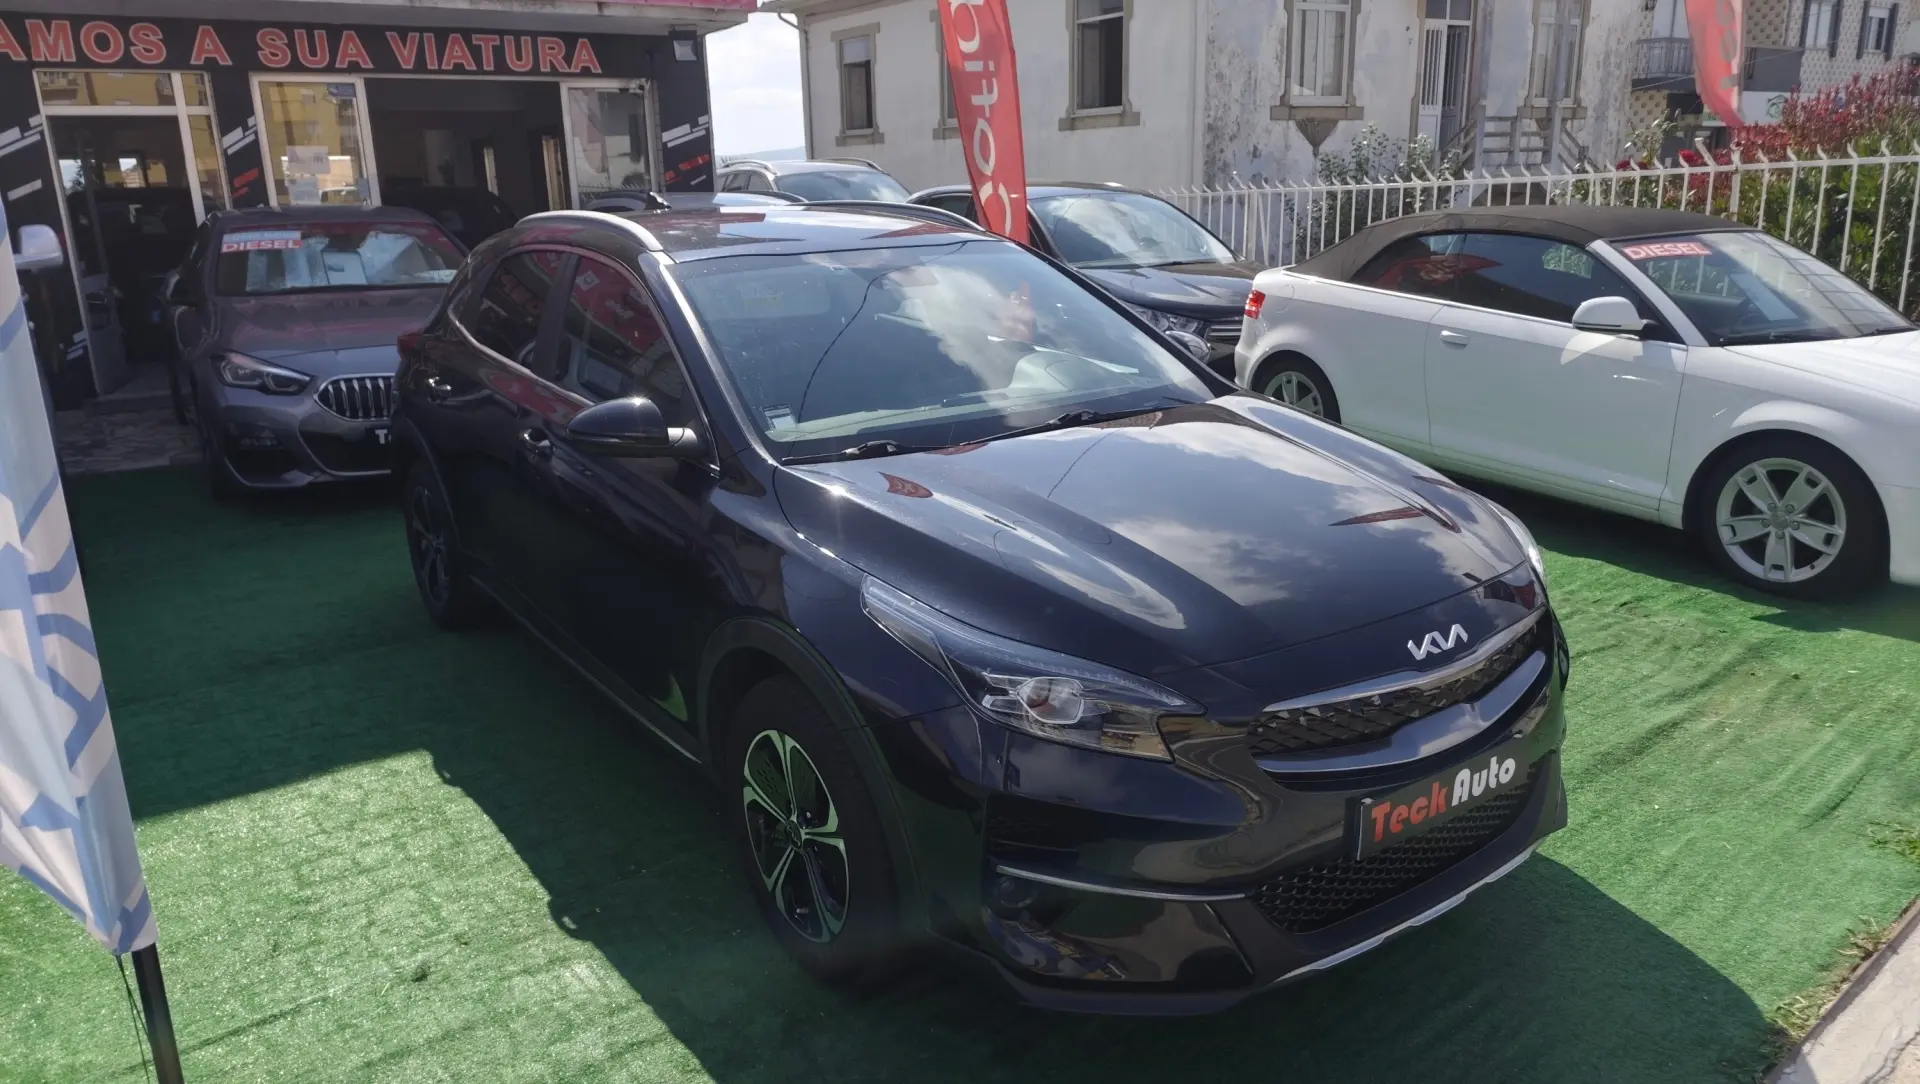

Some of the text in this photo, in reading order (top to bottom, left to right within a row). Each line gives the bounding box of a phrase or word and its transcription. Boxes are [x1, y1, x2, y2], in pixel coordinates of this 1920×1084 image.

[190, 25, 233, 65] A
[256, 28, 374, 69] SUA
[385, 31, 602, 73] VIATURA
[222, 239, 302, 253] DIESEL
[1622, 242, 1712, 260] DIESEL
[1371, 756, 1516, 842] Teck Auto
